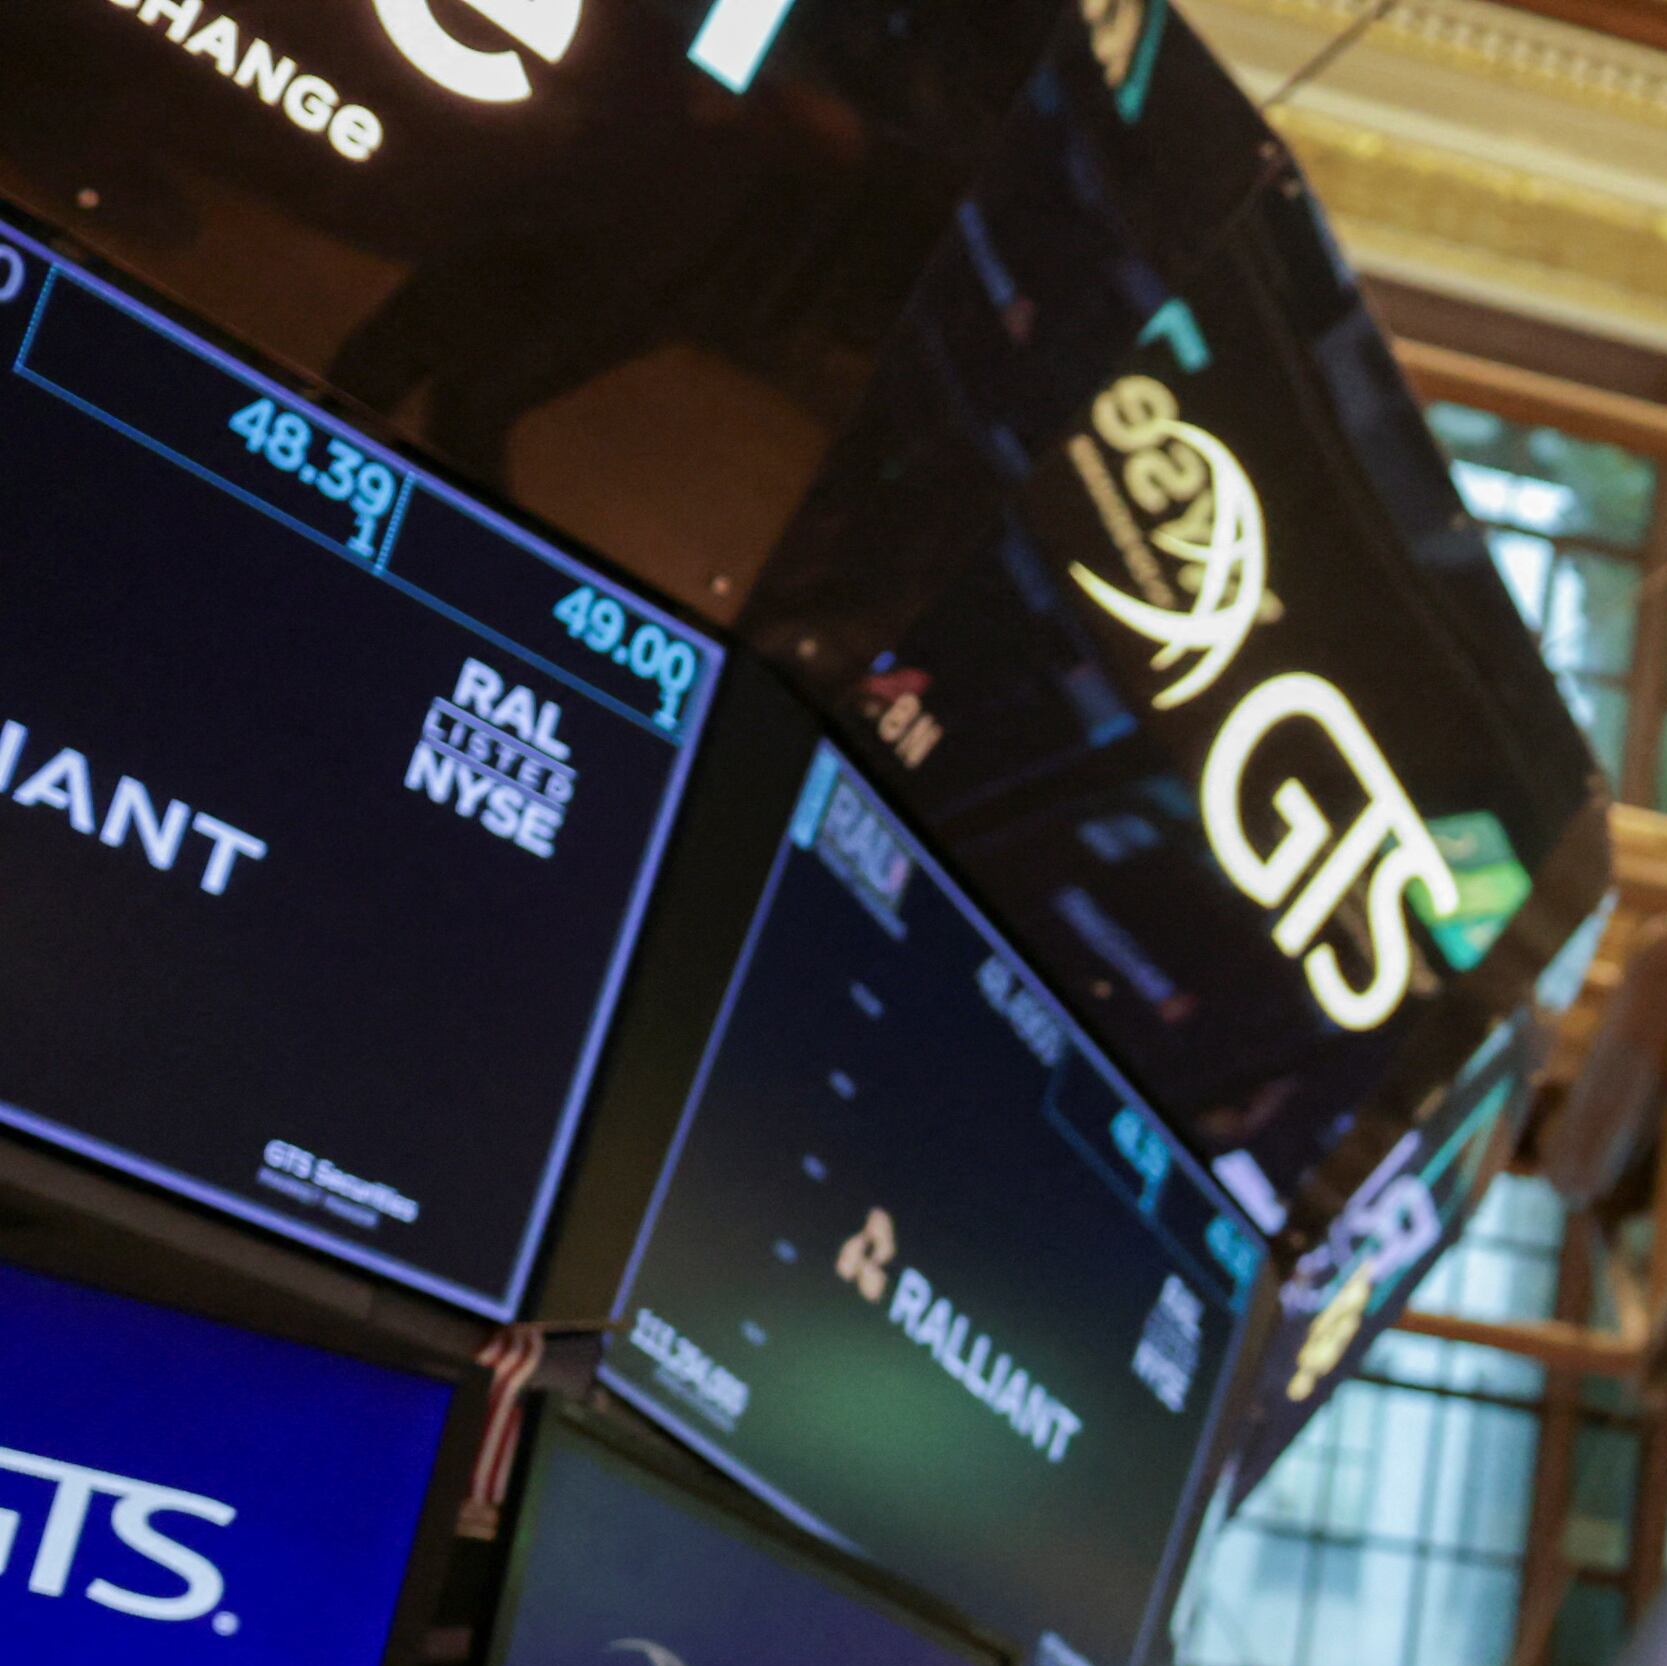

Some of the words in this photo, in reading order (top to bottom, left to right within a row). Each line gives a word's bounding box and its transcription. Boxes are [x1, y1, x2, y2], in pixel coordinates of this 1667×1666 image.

[228, 398, 397, 518] 48.39
[553, 586, 696, 693] 49.00
[423, 707, 575, 802] LISTED
[451, 657, 572, 761] RAL
[0, 718, 268, 896] IANT
[403, 744, 565, 858] NYSE
[1201, 670, 1461, 1031] GTS
[889, 1267, 1083, 1464] RALLIANT
[0, 1446, 238, 1622] TS
